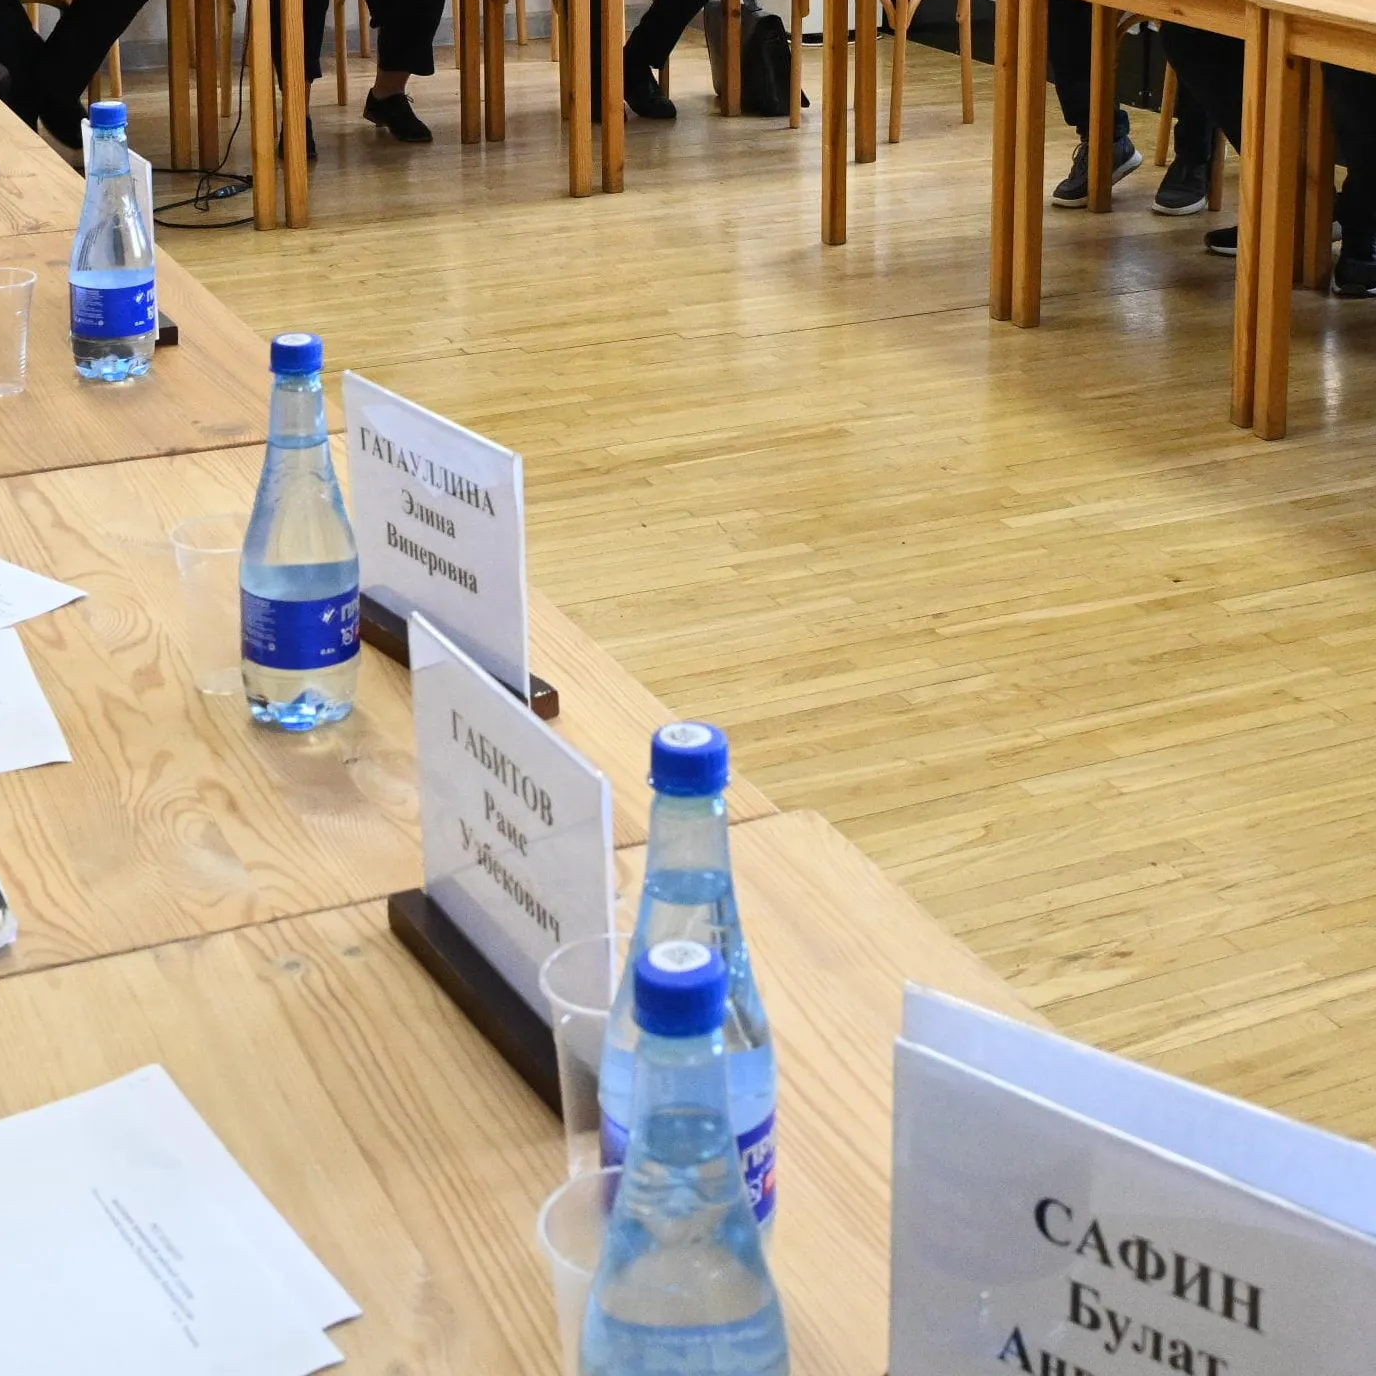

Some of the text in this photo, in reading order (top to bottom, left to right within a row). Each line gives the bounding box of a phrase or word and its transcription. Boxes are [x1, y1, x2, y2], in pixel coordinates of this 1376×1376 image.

[359, 426, 497, 517] ГАТАУЛЛИНА
[401, 488, 456, 540] Элина
[386, 521, 479, 595] Винеровна
[450, 707, 555, 827] ГАБИТОВ
[482, 789, 529, 858] Раис
[459, 817, 562, 943] Узбекович
[1033, 1192, 1269, 1337] САФИН
[1067, 1279, 1230, 1376] Булат
